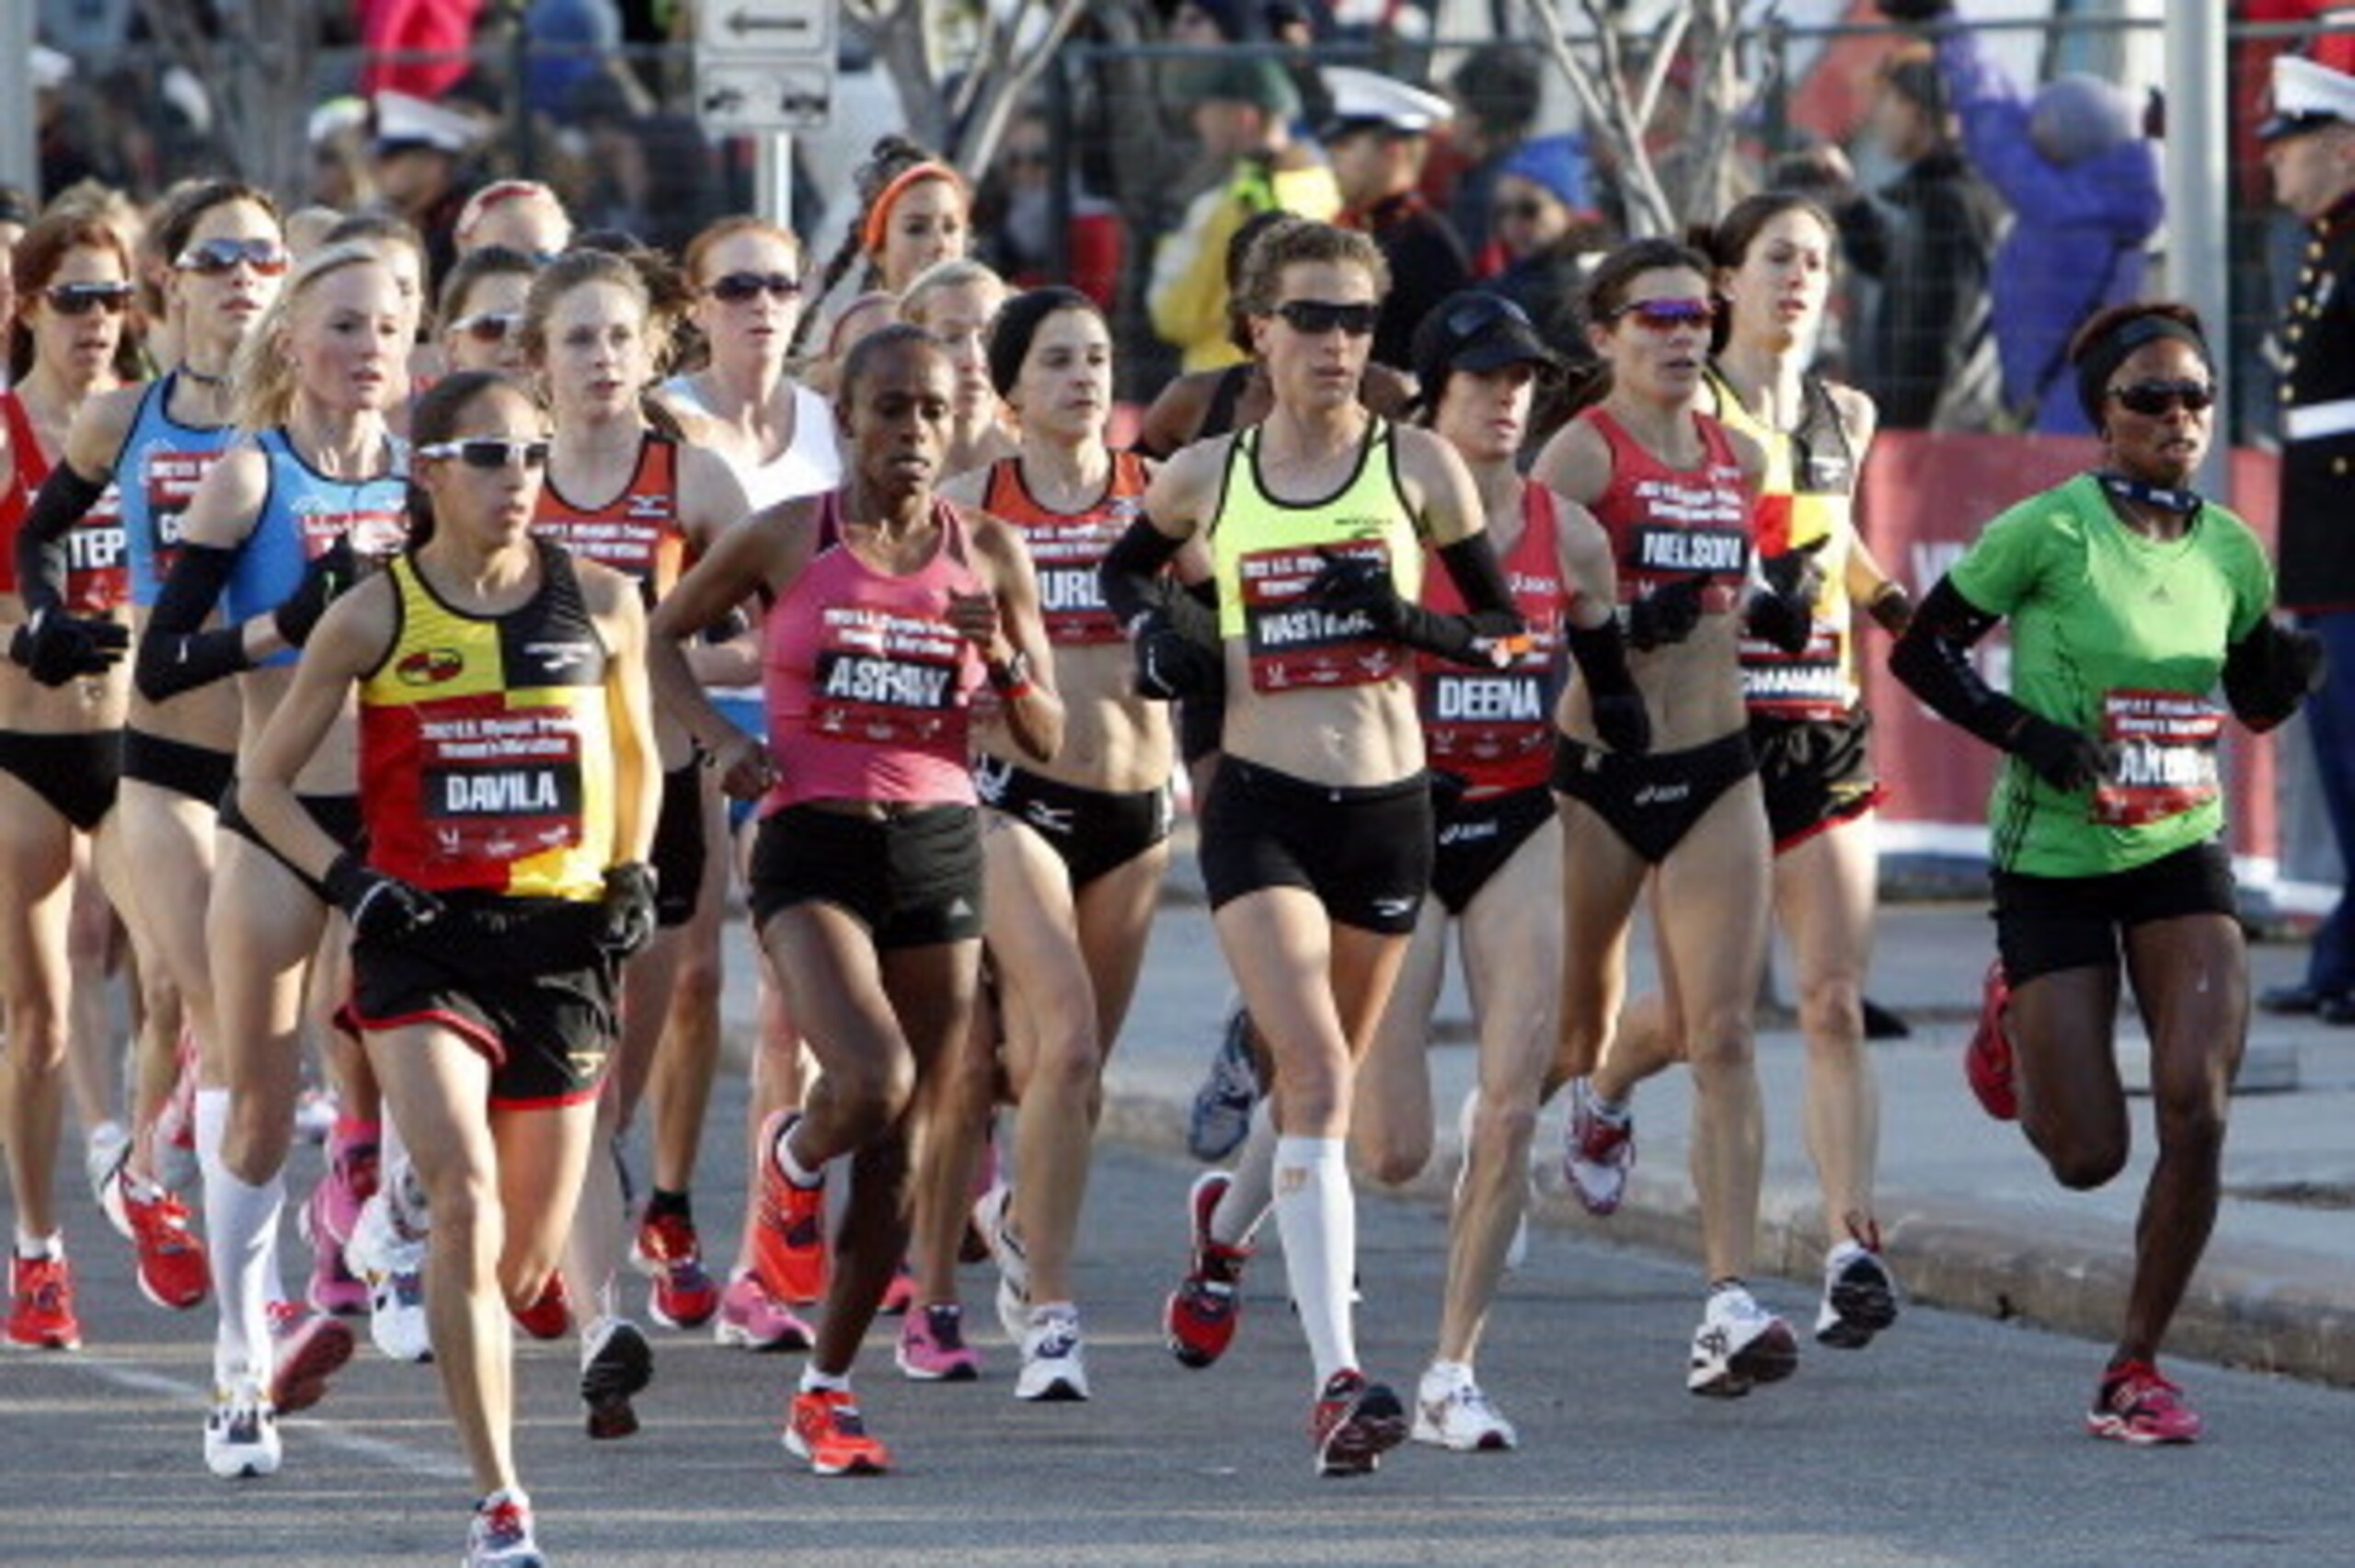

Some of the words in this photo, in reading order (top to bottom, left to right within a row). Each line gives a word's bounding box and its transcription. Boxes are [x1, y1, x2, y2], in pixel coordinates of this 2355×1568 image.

[1643, 531, 1741, 569] NELSON
[1438, 677, 1543, 721] DEENA
[445, 772, 559, 812] DAVILA
